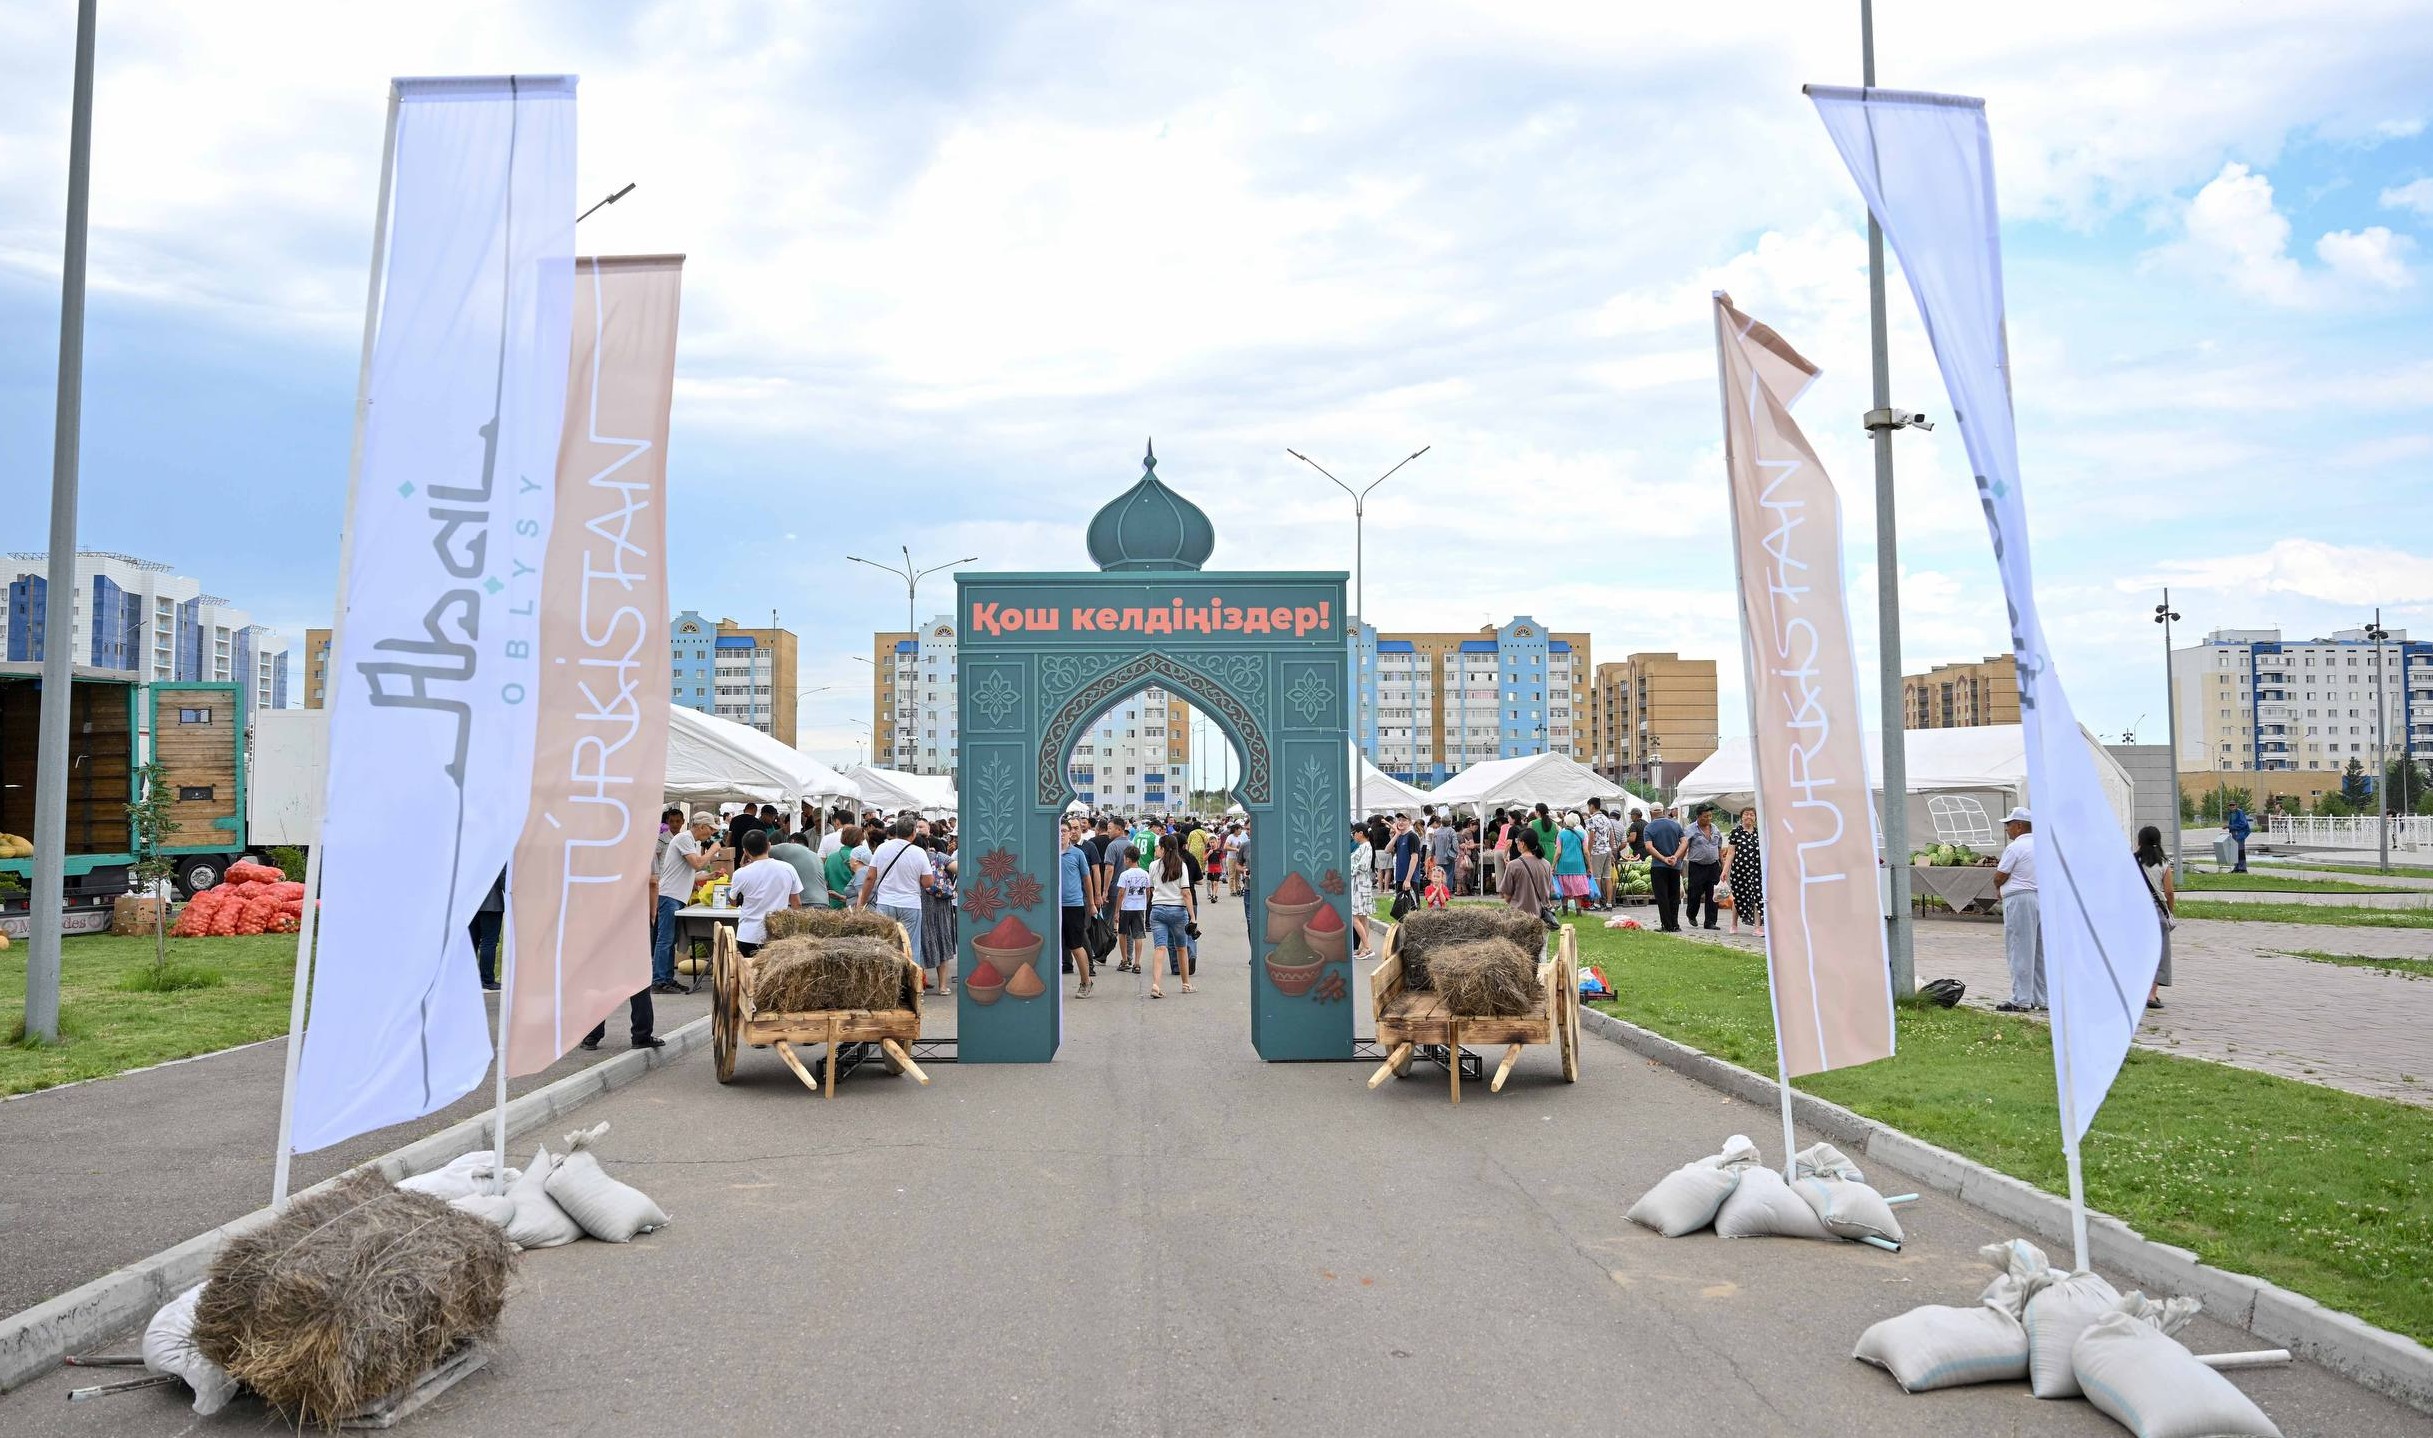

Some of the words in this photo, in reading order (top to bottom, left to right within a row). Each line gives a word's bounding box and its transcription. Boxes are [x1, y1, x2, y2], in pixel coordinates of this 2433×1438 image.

[501, 474, 542, 705] OBLYSY
[973, 602, 1059, 636] Қош
[1073, 597, 1330, 637] келдіңіздер!
